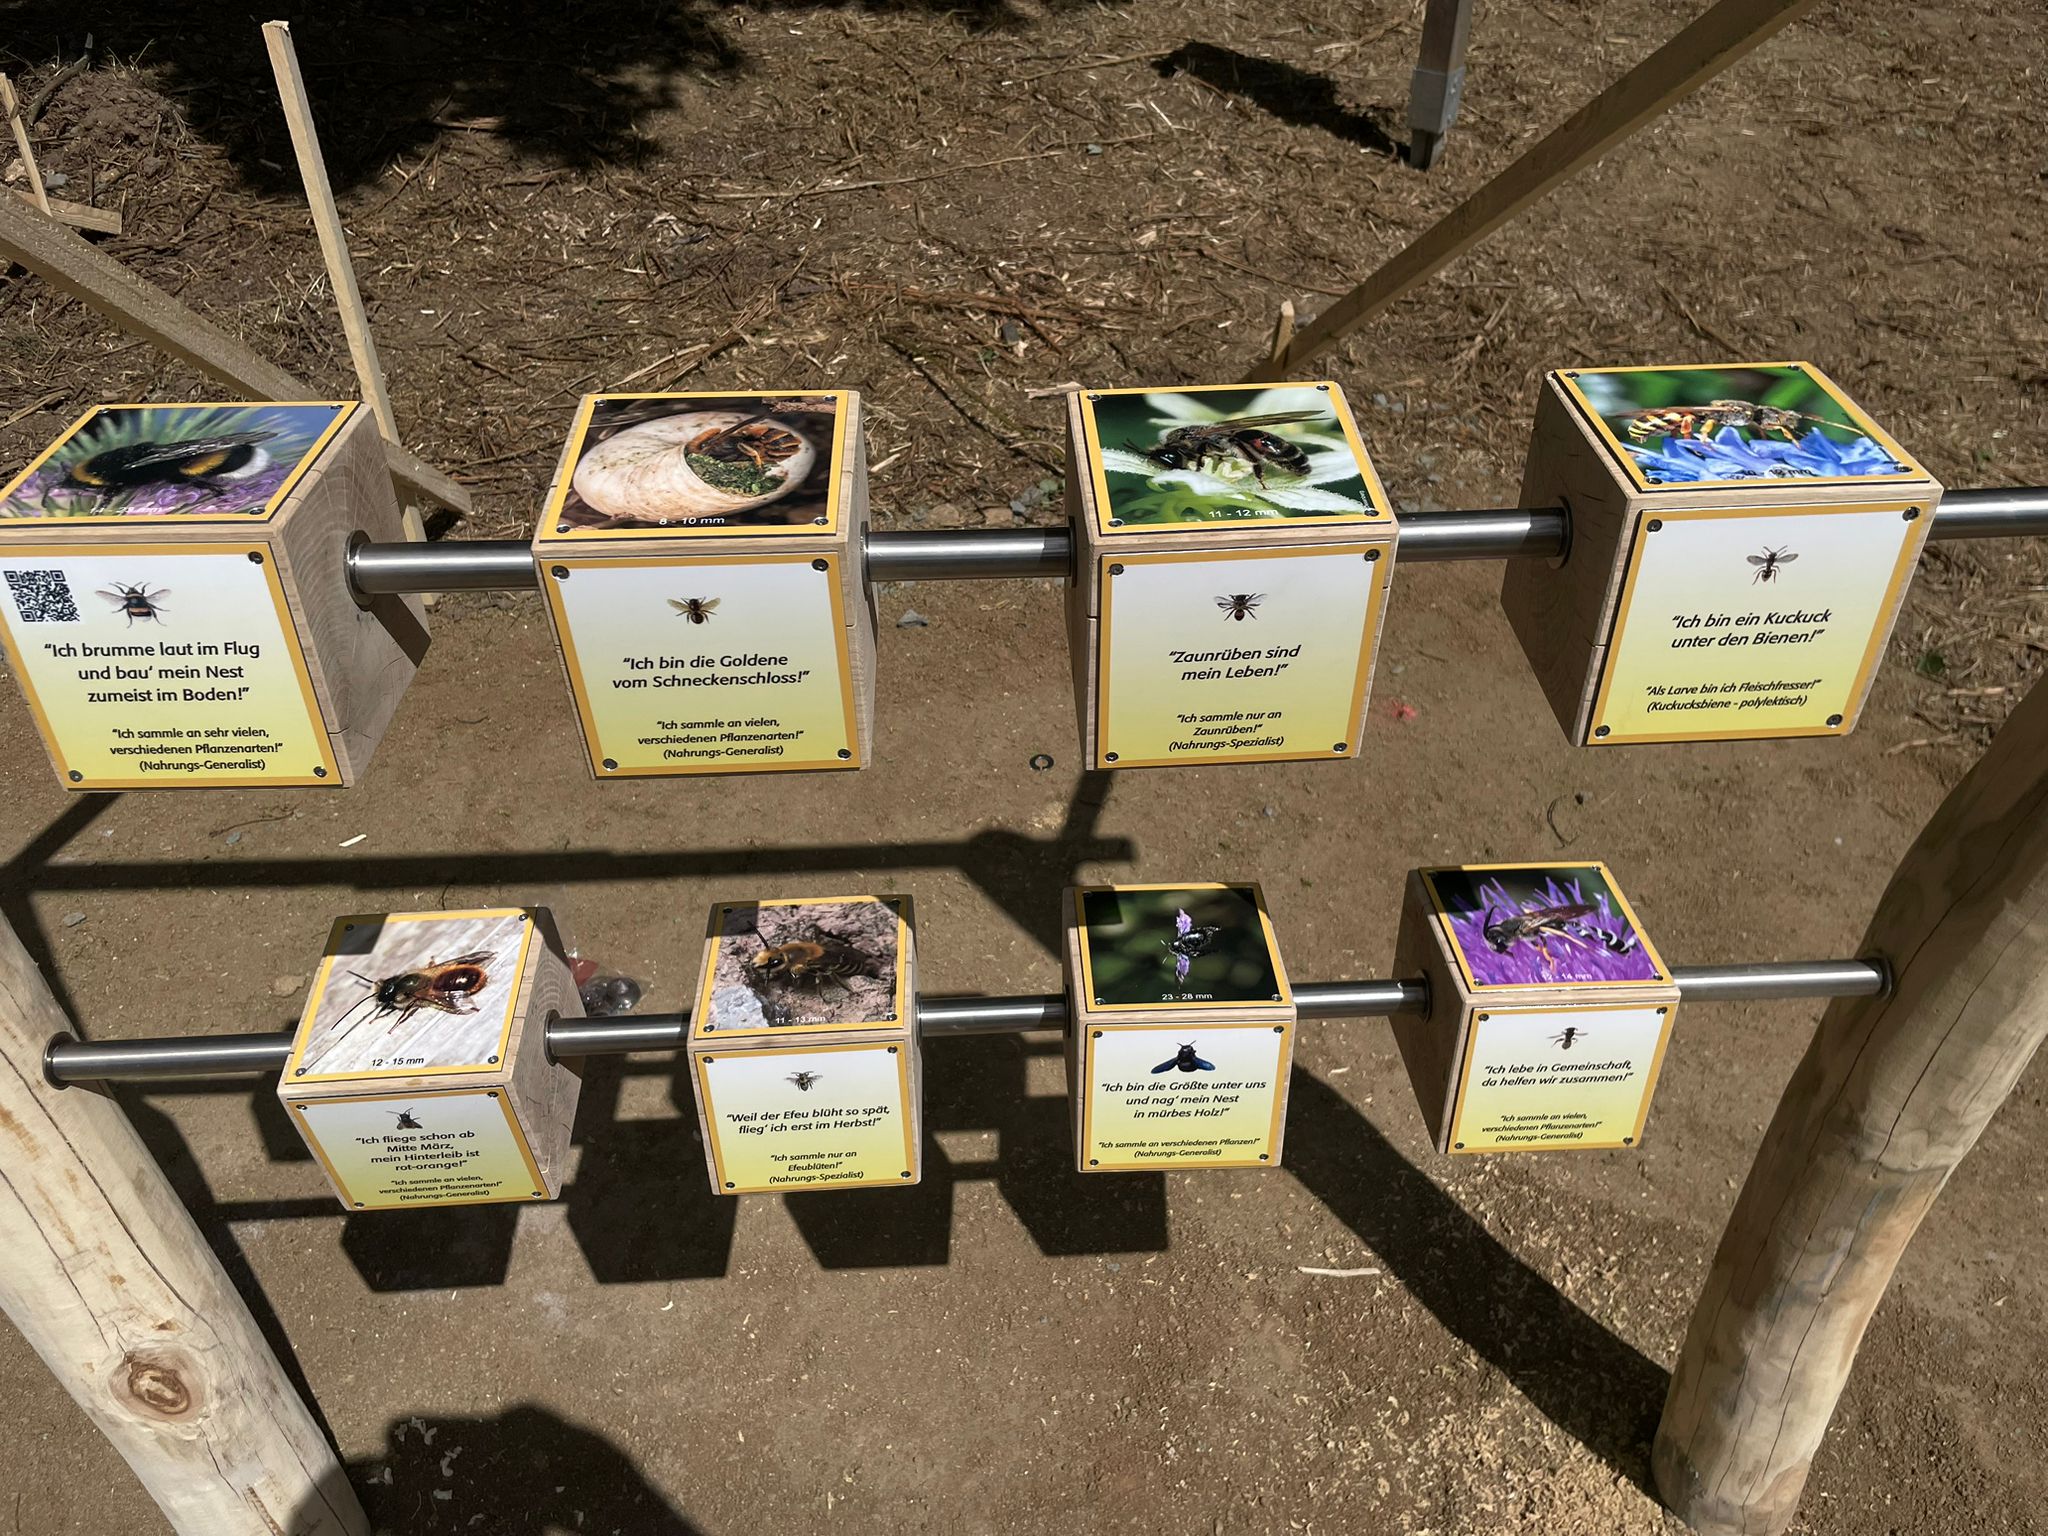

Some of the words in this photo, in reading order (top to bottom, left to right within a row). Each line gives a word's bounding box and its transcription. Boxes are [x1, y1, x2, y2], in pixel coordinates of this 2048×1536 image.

[1704, 614, 1731, 627] bin
[1735, 613, 1760, 626] ein
[1764, 609, 1832, 625] Kuckuck
[1671, 635, 1715, 648] unter
[1718, 633, 1749, 646] den
[82, 642, 154, 657] brumme
[160, 642, 193, 656] laut
[197, 642, 218, 655] im
[224, 641, 260, 658] Flug
[1265, 645, 1301, 658] sind
[659, 657, 684, 669] bin
[690, 656, 715, 668] die
[720, 654, 788, 667] Goldene
[78, 666, 110, 680] und
[158, 666, 200, 679] mein
[206, 666, 244, 678] Nest
[1181, 668, 1221, 680] mein
[613, 678, 647, 688] vom
[1667, 685, 1697, 695] Larve
[1700, 684, 1718, 693] bin
[1720, 683, 1736, 693] ich
[88, 689, 152, 703] zumeist
[157, 689, 177, 701] im
[1647, 699, 1731, 713] (Kuckucksbiene
[1739, 695, 1807, 709] polylektisch)
[1200, 712, 1243, 722] sammle
[1267, 711, 1281, 719] an
[681, 719, 724, 729] sammle
[728, 720, 741, 728] an
[745, 718, 780, 727] vielen,
[138, 728, 184, 738] sammle
[187, 730, 201, 738] an
[204, 728, 228, 738] sehr
[232, 728, 270, 738] vielen,
[638, 734, 717, 745] verschiedenen
[1169, 737, 1284, 752] (Nahrungs-Spezialist)
[110, 744, 192, 755] verschiedenen
[663, 746, 783, 760] (Nahrungs-Generalist)
[139, 759, 266, 772] (Nahrungs-Generalist)
[1509, 1064, 1534, 1073] lebe
[1536, 1064, 1547, 1072] in
[1551, 1060, 1632, 1071] Gemeinschaft,
[1126, 1082, 1145, 1091] bin
[1148, 1082, 1166, 1091] die
[1169, 1081, 1209, 1091] Größte
[1212, 1081, 1242, 1089] unter
[1482, 1079, 1496, 1087] da
[1500, 1077, 1536, 1086] helfen
[1539, 1076, 1558, 1084] wir
[1126, 1096, 1149, 1105] und
[1180, 1095, 1210, 1103] mein
[1213, 1095, 1239, 1103] Nest
[760, 1112, 780, 1121] der
[783, 1111, 809, 1120] Efeu
[812, 1108, 842, 1118] blüht
[862, 1106, 890, 1116] spät,
[1134, 1110, 1144, 1118] in
[1148, 1109, 1191, 1118] mürbes
[1563, 1112, 1587, 1120] vielen,
[770, 1123, 787, 1132] ich
[791, 1122, 812, 1130] erst
[816, 1121, 830, 1129] im
[1482, 1125, 1538, 1133] verschiedenen
[383, 1135, 417, 1144] fliege
[420, 1133, 455, 1141] schon
[1496, 1132, 1583, 1142] (Nahrungs-Generalist)
[405, 1151, 462, 1161] Hinterleib
[1134, 1149, 1221, 1158] (Nahrungs-Generalist)
[769, 1172, 864, 1184] (Nahrungs-Spezialist)
[379, 1186, 438, 1194] verschiedenen
[400, 1190, 489, 1201] (Nahrungs-Generalist)
